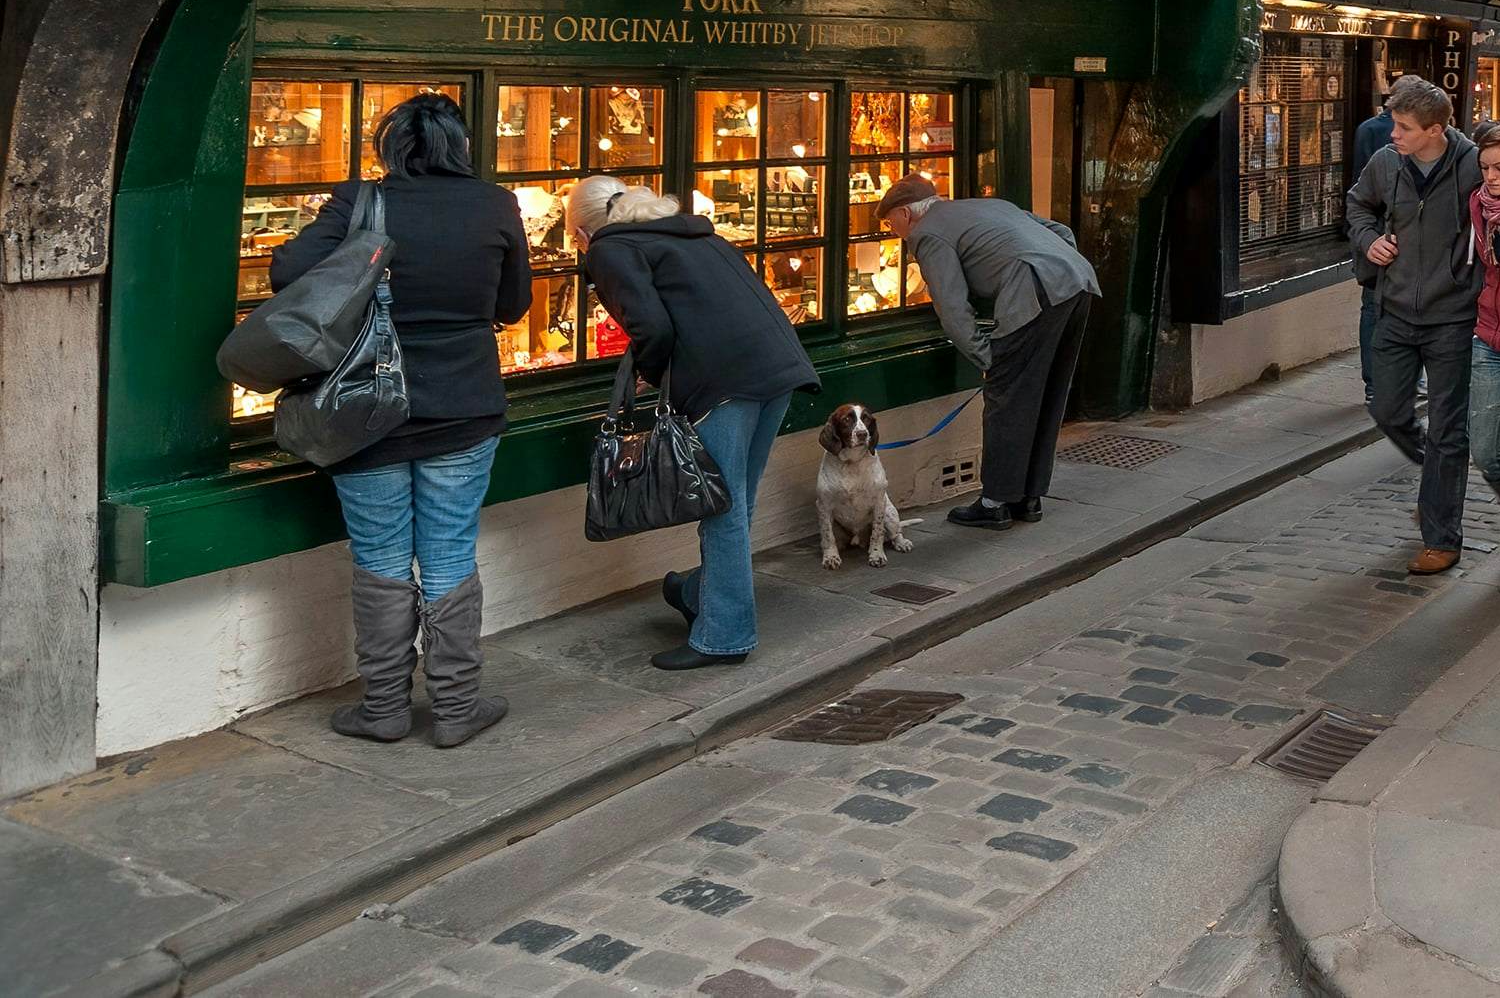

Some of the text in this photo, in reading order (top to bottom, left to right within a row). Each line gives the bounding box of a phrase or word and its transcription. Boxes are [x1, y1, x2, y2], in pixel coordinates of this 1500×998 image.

[481, 14, 904, 52] THE ORIGINAL WHITBY JET SHOP
